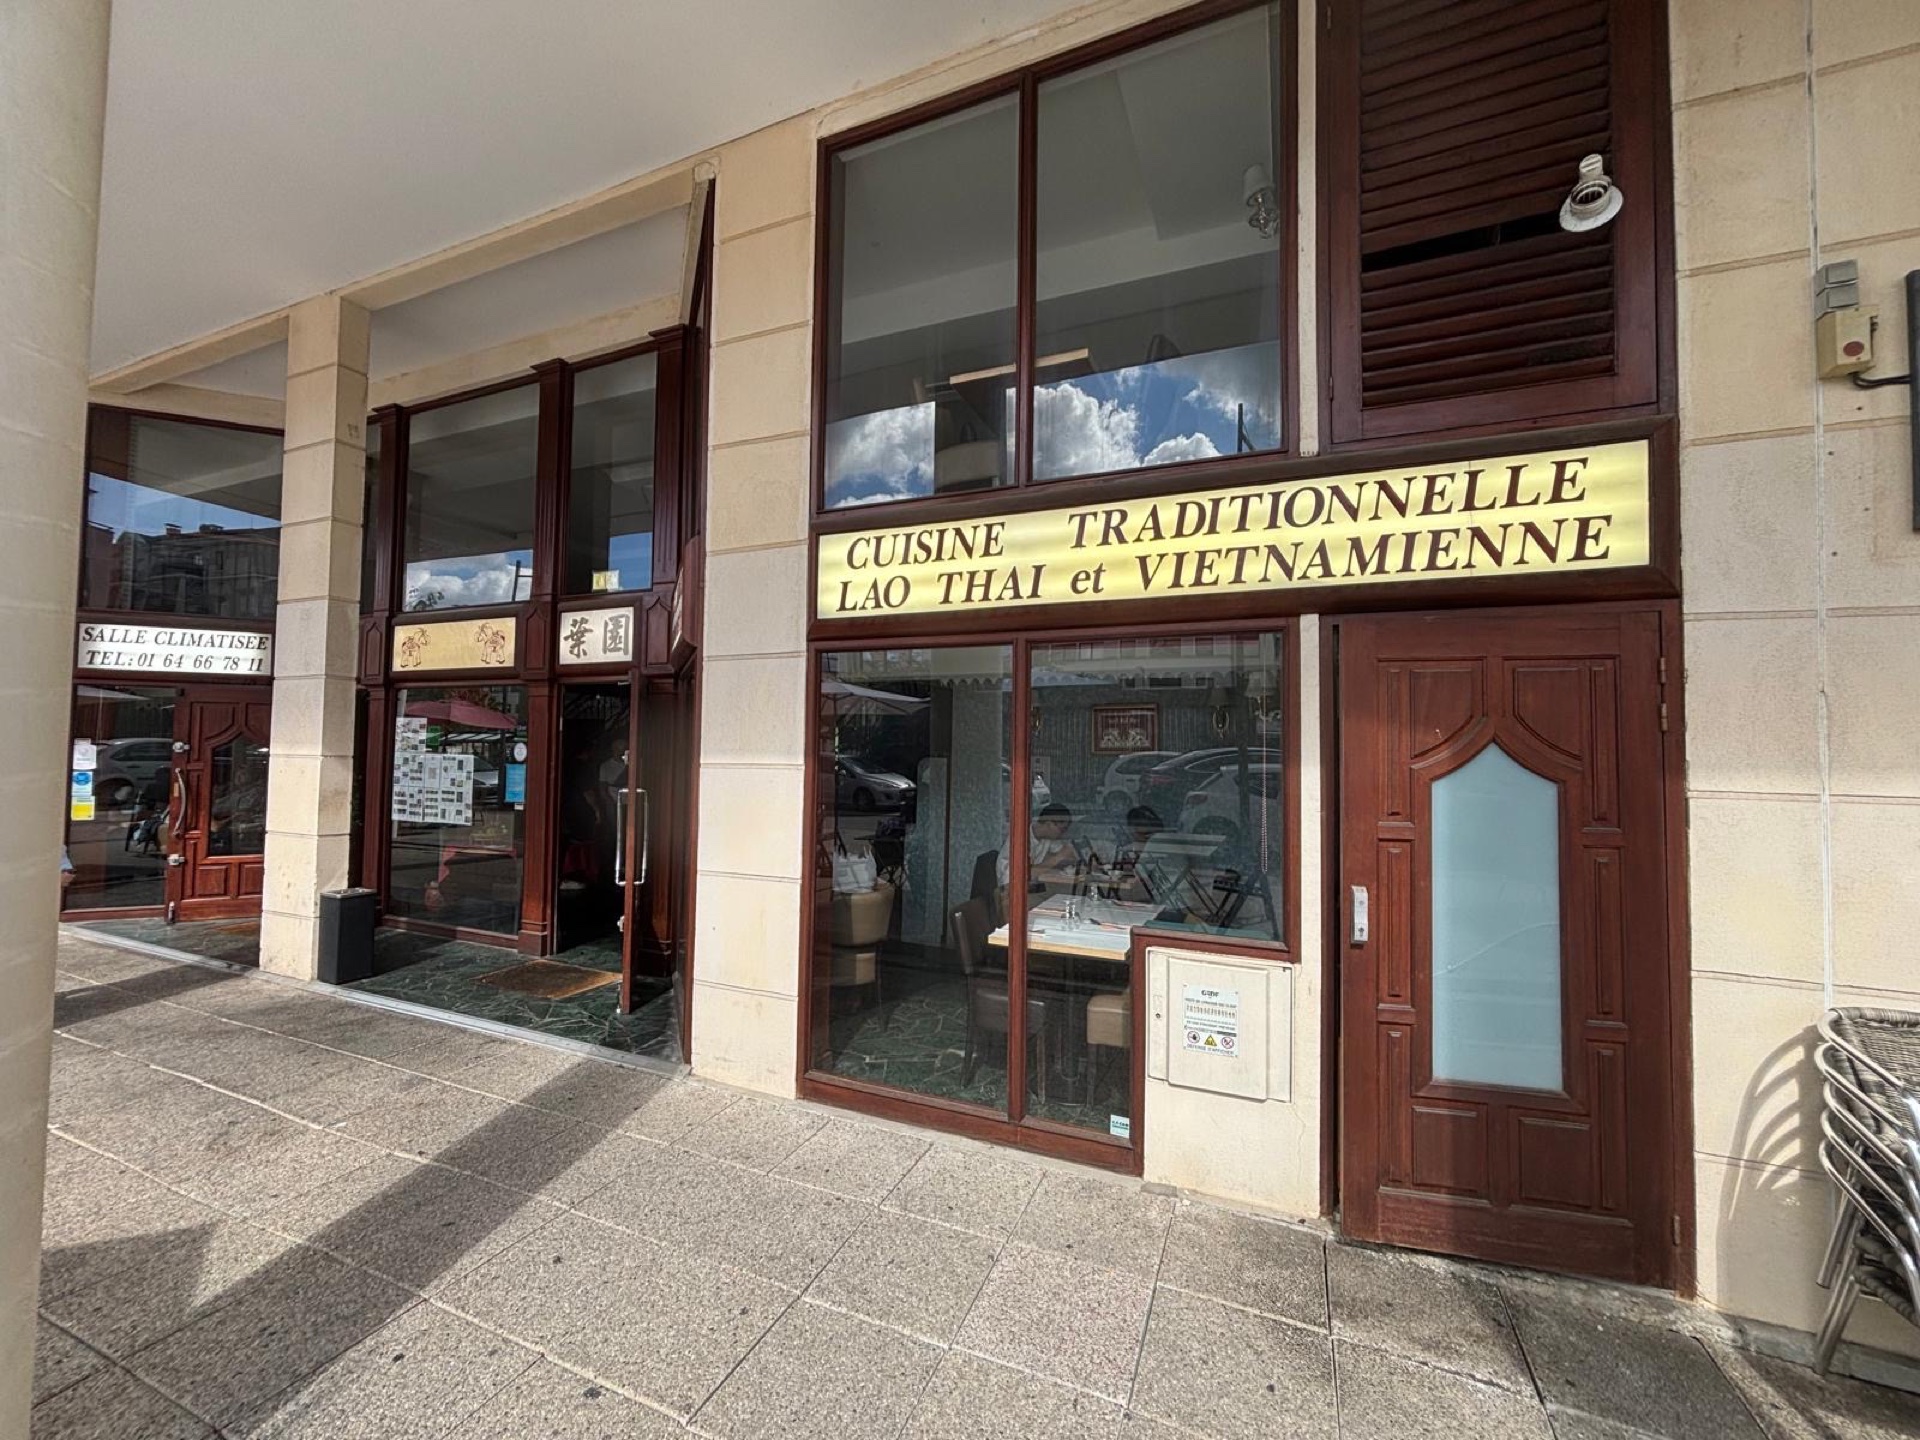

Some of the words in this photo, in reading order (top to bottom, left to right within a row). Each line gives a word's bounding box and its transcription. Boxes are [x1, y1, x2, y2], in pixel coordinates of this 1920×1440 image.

[846, 521, 1006, 570] CUISINE
[1068, 456, 1589, 549] TRADITIONNELLE
[836, 575, 911, 612] LAO
[937, 563, 1047, 605] THAI
[1070, 562, 1107, 595] et
[1135, 514, 1613, 591] VIETNAMIENNE
[82, 626, 148, 644] SALLE
[154, 631, 268, 650] CLIMATISEE
[163, 653, 184, 668] 64
[193, 654, 213, 669] 66
[223, 656, 241, 672] 78
[248, 658, 263, 672] 11
